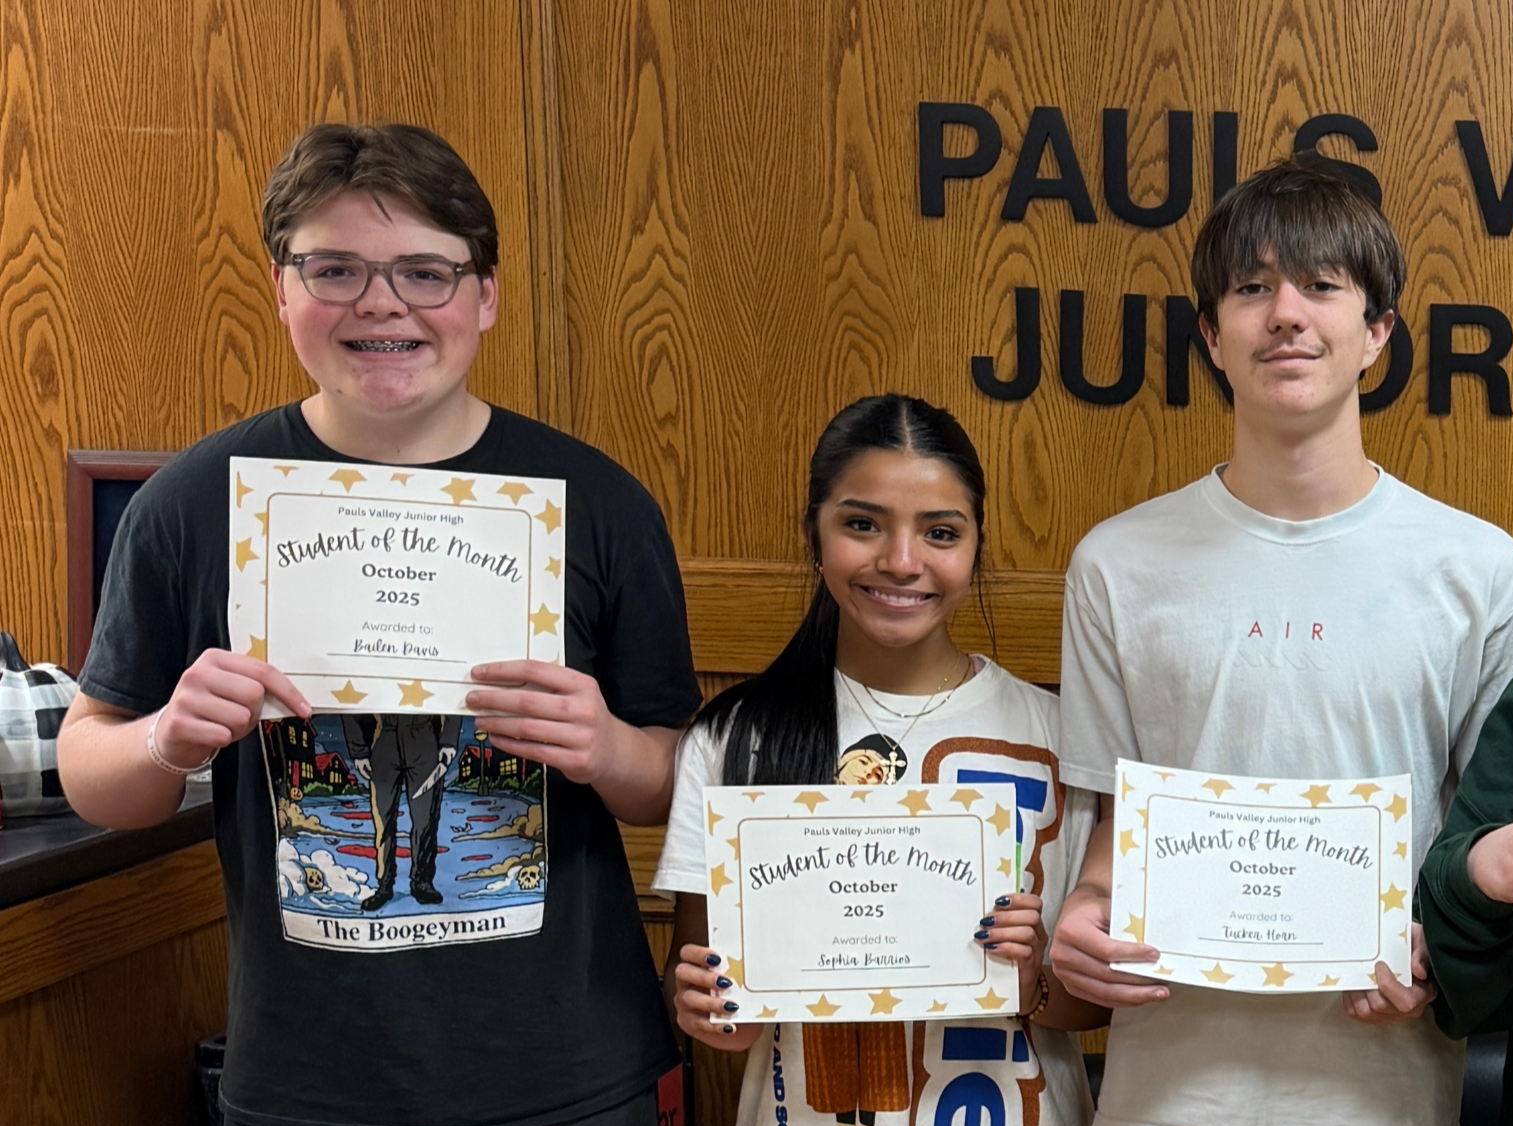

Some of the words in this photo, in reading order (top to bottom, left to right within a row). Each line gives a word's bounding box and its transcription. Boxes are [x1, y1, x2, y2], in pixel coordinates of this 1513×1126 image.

[970, 287, 1513, 418] JUNR
[338, 507, 366, 517] Pauls
[369, 508, 401, 521] Valley
[404, 512, 437, 523] Junior
[440, 513, 464, 525] High
[277, 527, 366, 568] Student
[371, 528, 396, 552] of
[402, 527, 440, 553] the
[447, 536, 522, 583] Month
[361, 563, 437, 582] October
[375, 589, 420, 606] 2025
[362, 621, 415, 633] Awarded
[420, 625, 433, 634] to:
[1247, 620, 1324, 642] AIR
[402, 641, 439, 656] Davis
[1209, 811, 1234, 820] Pauls
[1236, 813, 1265, 824] Valley
[1267, 815, 1297, 824] Junior
[1299, 815, 1321, 825] High
[804, 827, 829, 836] Pauls
[832, 827, 862, 837] Valley
[864, 826, 896, 836] Junior
[898, 826, 921, 836] High
[1155, 829, 1233, 859] Student
[1238, 829, 1259, 850] of
[1266, 829, 1299, 851] the
[1306, 834, 1373, 870] Month
[749, 847, 830, 890] Student
[836, 844, 858, 868] of
[864, 842, 900, 866] the
[907, 846, 977, 886] Month
[1229, 860, 1296, 876] October
[829, 880, 898, 894] October
[1242, 884, 1282, 897] 2025
[843, 905, 884, 918] 2025
[1230, 911, 1277, 921] Awarded
[1280, 914, 1293, 922] to:
[317, 918, 360, 941] The
[368, 916, 506, 942] Boogeyman
[1222, 926, 1262, 941] Tucker
[1267, 929, 1297, 941] Horn
[832, 935, 881, 945] Awarded
[885, 935, 897, 943] to:
[818, 953, 859, 970] Sophia
[865, 953, 910, 966] Barrios
[773, 1046, 785, 1102] AND
